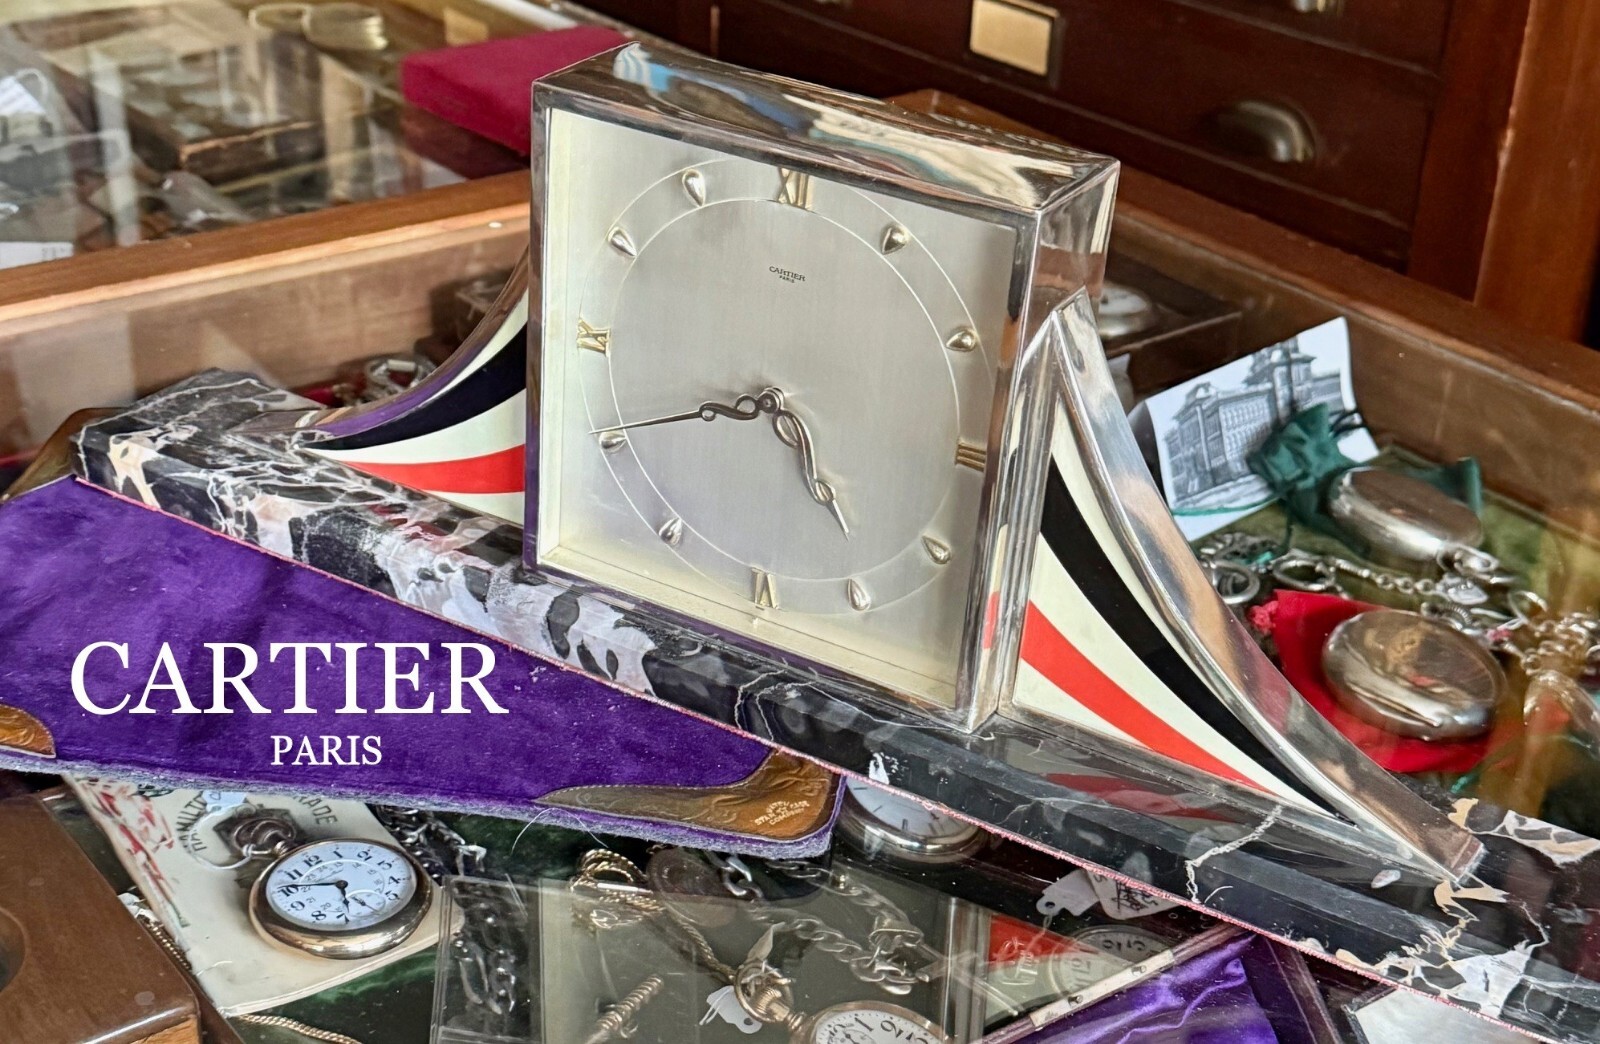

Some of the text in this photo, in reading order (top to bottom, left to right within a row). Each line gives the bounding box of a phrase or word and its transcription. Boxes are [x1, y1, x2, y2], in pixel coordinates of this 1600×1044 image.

[769, 265, 806, 281] CARTIER
[357, 850, 372, 861] 2
[303, 855, 322, 868] 12
[377, 860, 392, 870] 3
[287, 869, 303, 880] 11
[388, 875, 400, 884] 4
[279, 884, 299, 897] 10
[385, 890, 400, 901] 5
[290, 901, 306, 911] 9
[311, 910, 327, 921] 8
[854, 1017, 873, 1032] 1
[880, 1020, 903, 1038] 2
